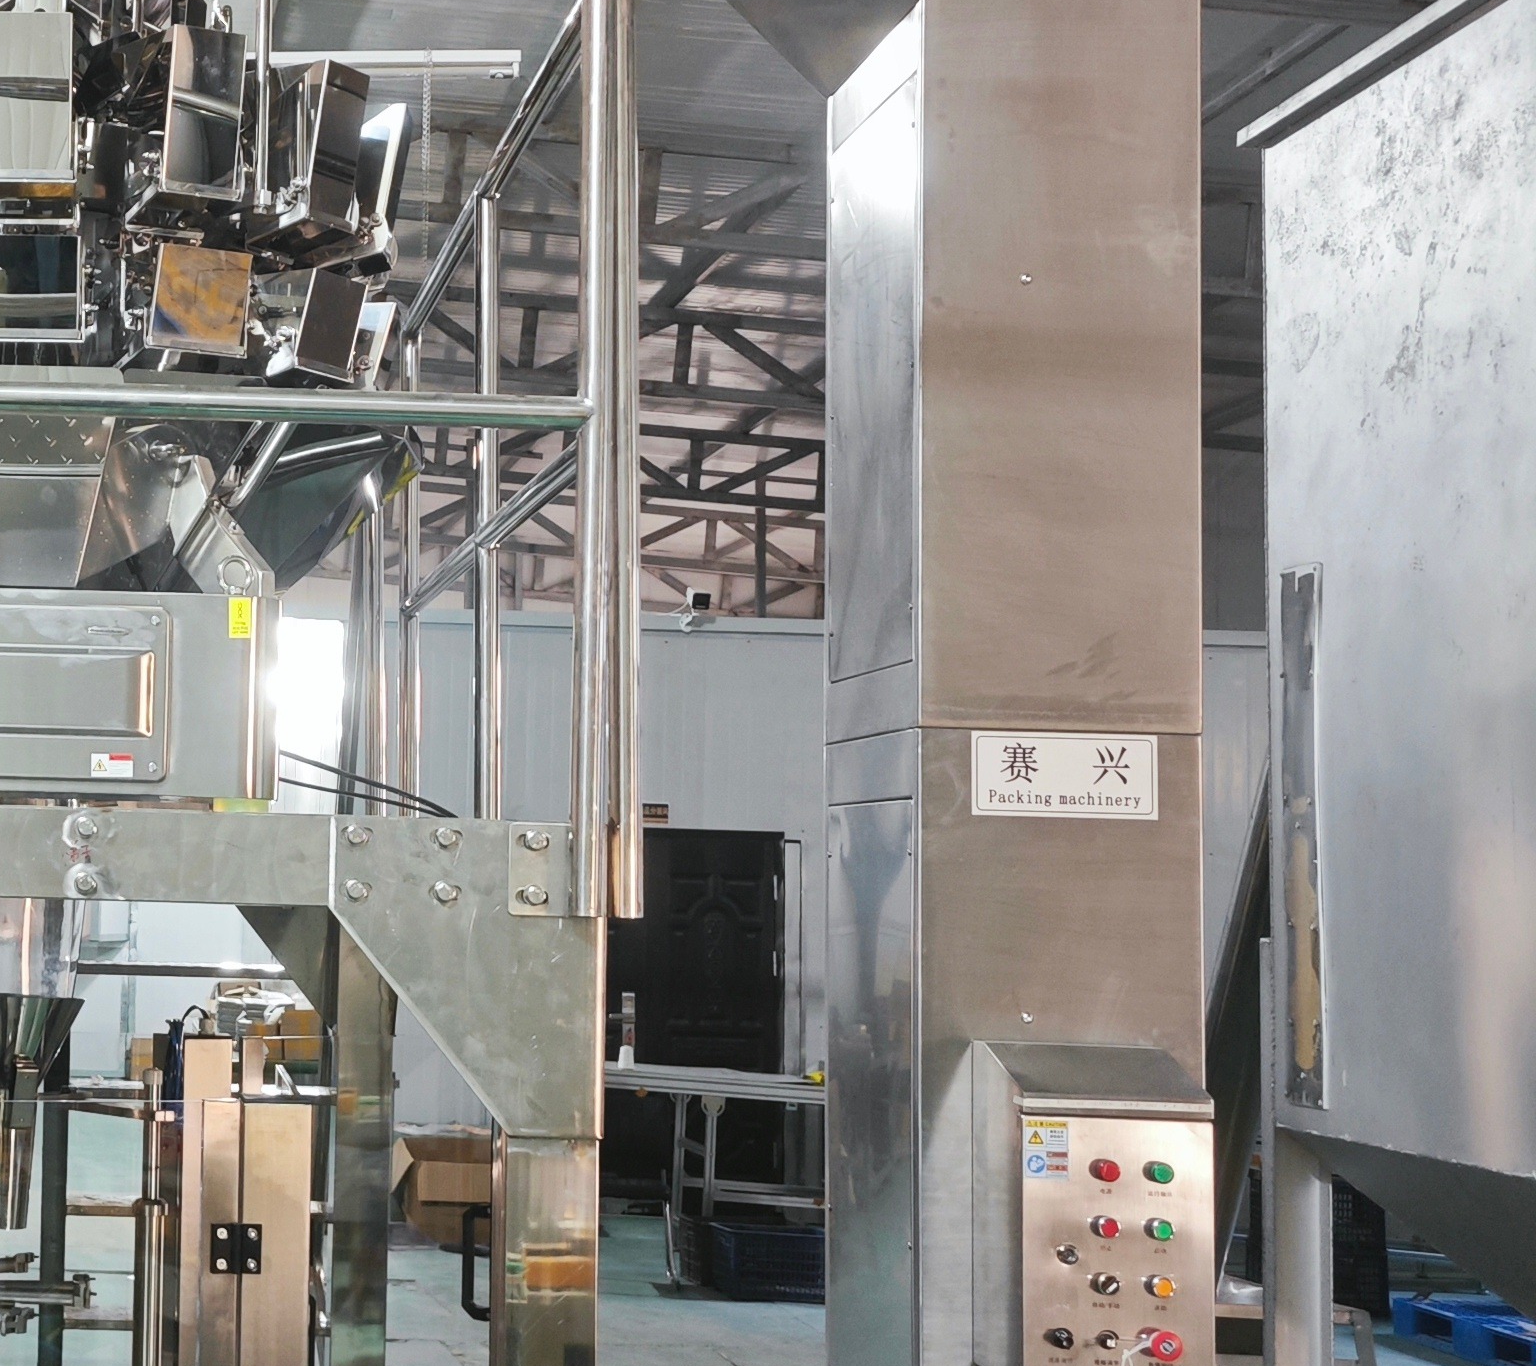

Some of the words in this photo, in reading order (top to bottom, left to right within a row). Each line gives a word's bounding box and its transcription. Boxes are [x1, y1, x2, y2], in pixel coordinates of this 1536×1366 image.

[999, 742, 1131, 785] 赛兴
[988, 789, 1052, 806] Packing
[1059, 792, 1142, 809] machinery
